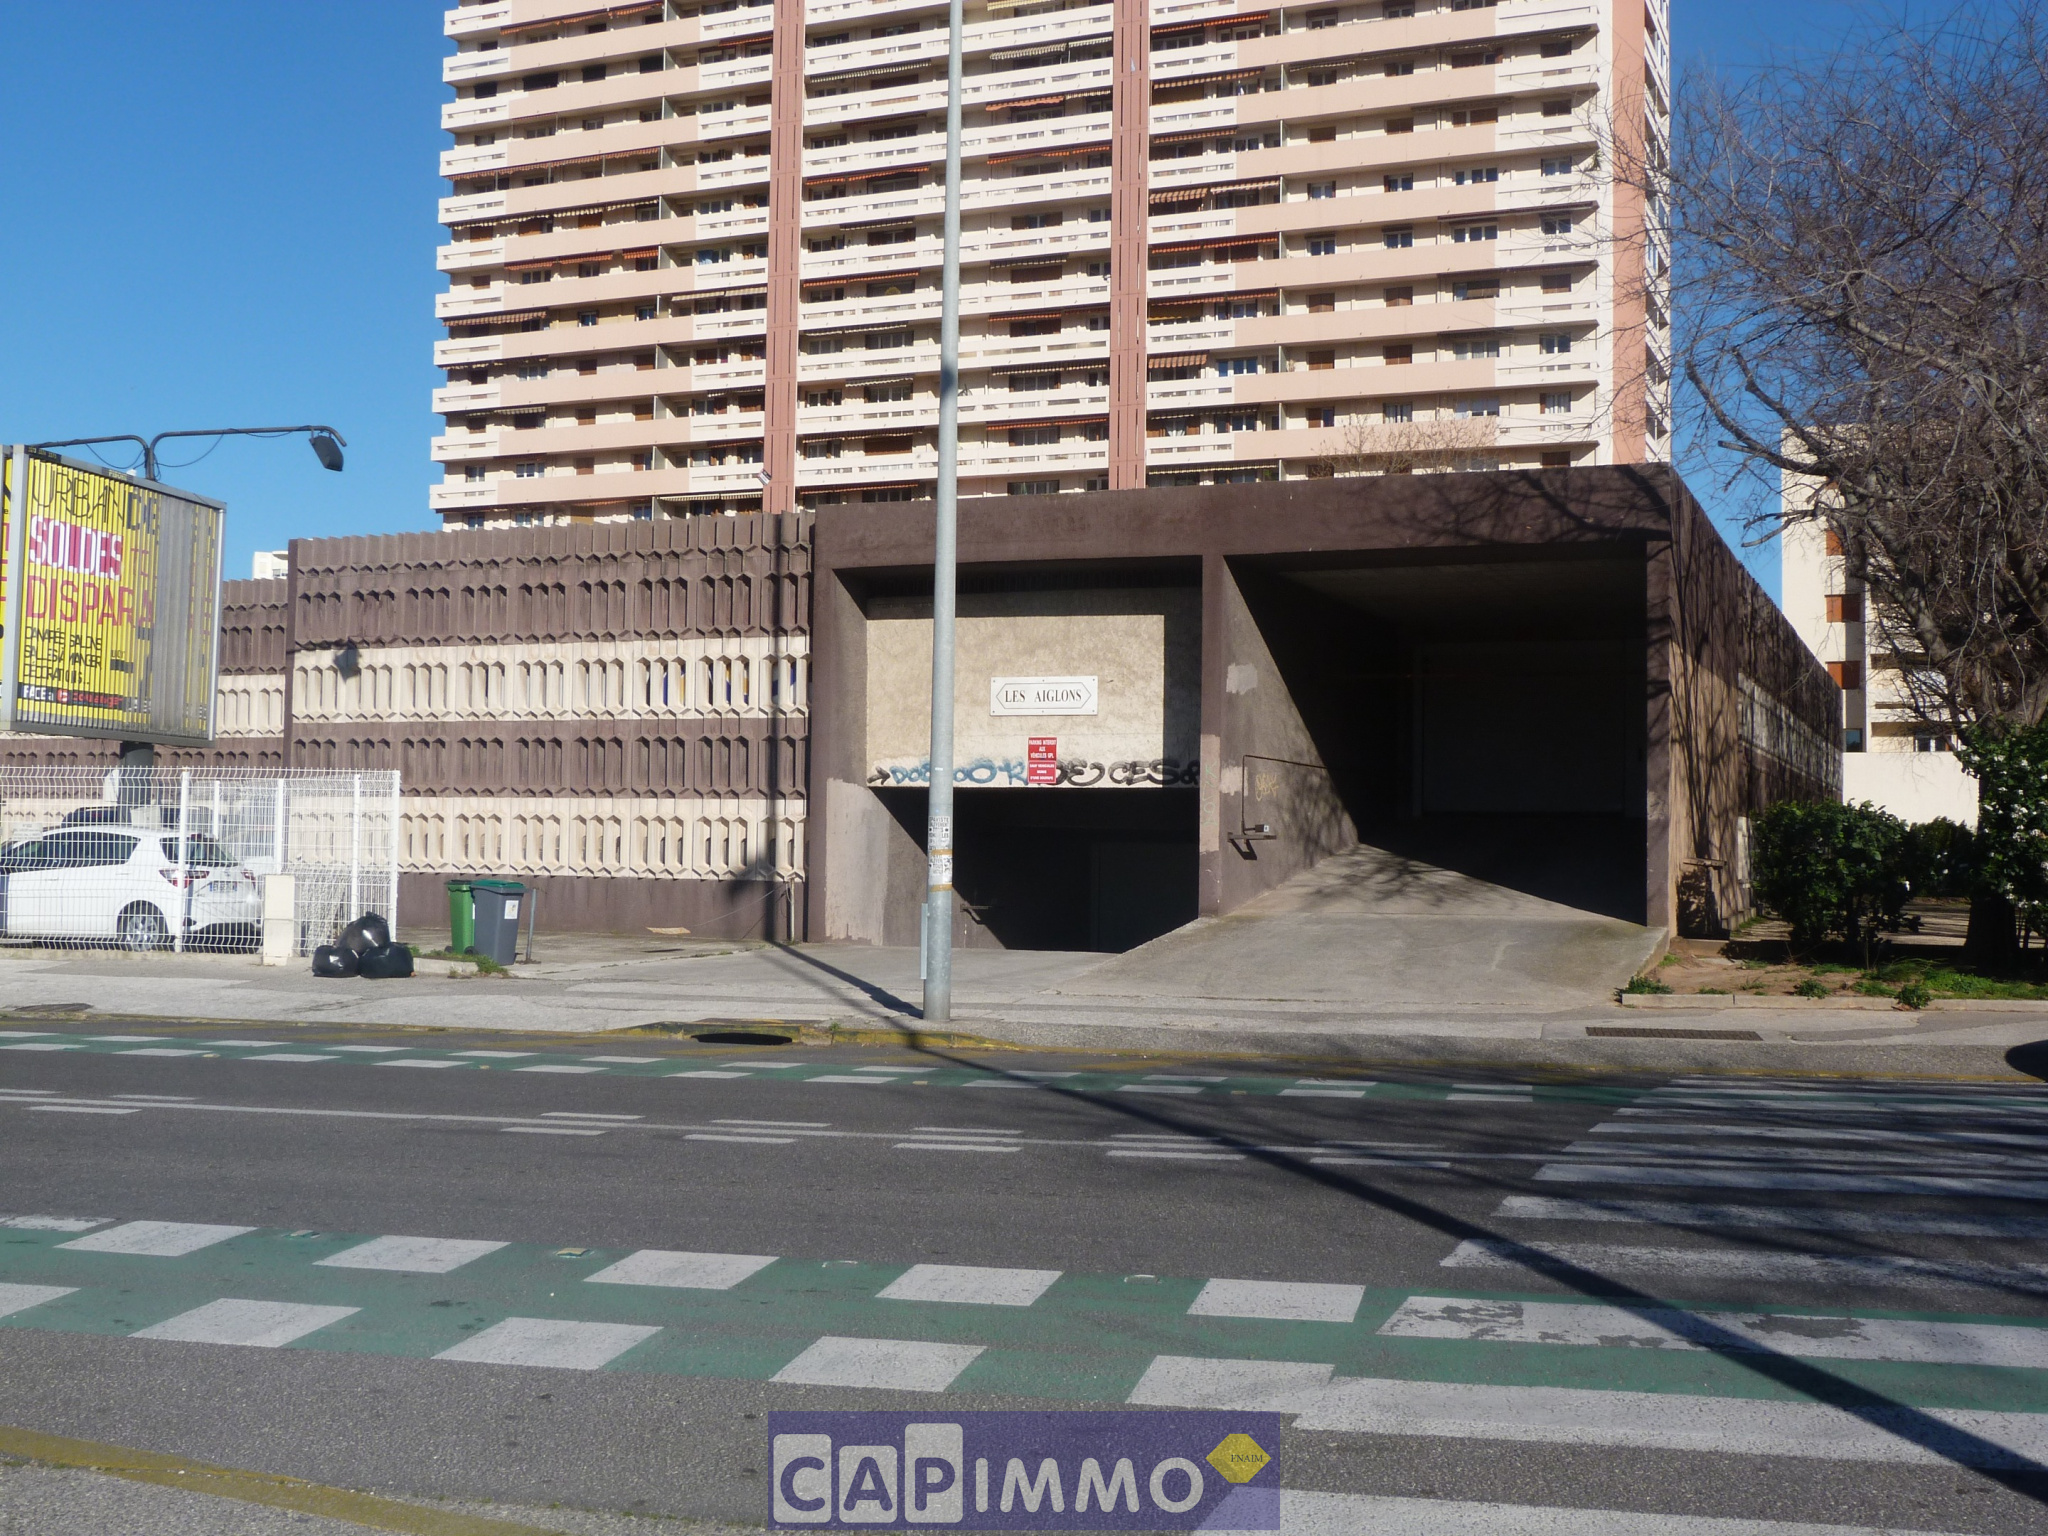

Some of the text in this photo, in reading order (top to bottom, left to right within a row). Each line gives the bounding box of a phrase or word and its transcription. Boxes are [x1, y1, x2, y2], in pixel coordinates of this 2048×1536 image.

[33, 464, 125, 527] URBAN
[29, 515, 123, 581] SOLDES
[23, 685, 47, 700] FACE
[1004, 688, 1083, 703] LES AIGLONS
